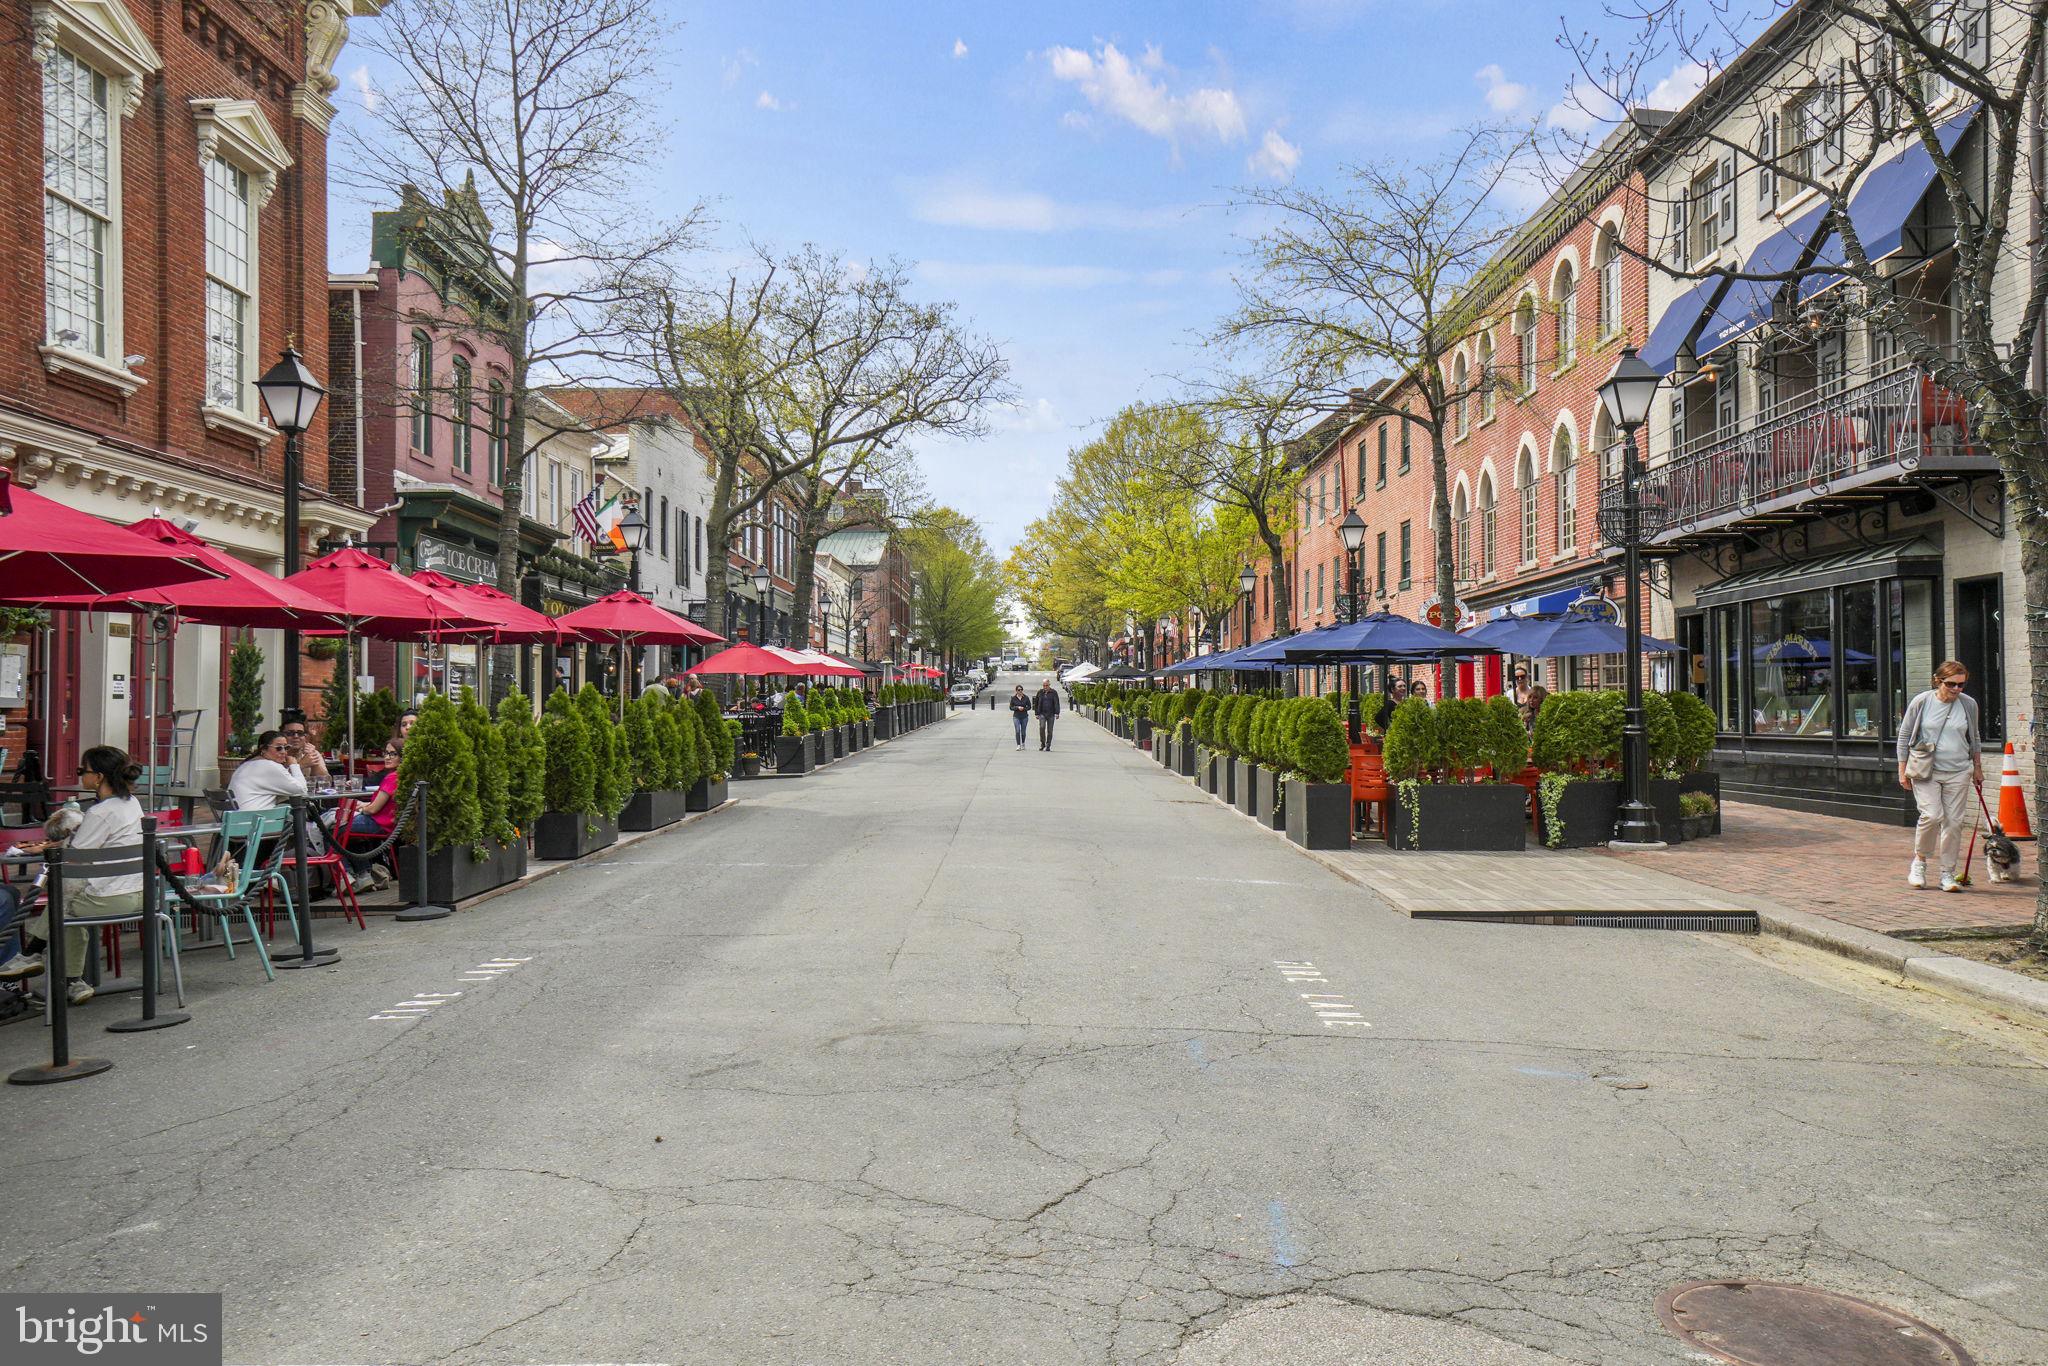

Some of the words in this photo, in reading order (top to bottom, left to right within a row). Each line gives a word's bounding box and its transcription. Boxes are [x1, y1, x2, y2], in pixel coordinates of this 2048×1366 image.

[447, 549, 467, 571] ICE
[466, 555, 498, 580] CREA
[1428, 611, 1461, 619] POS
